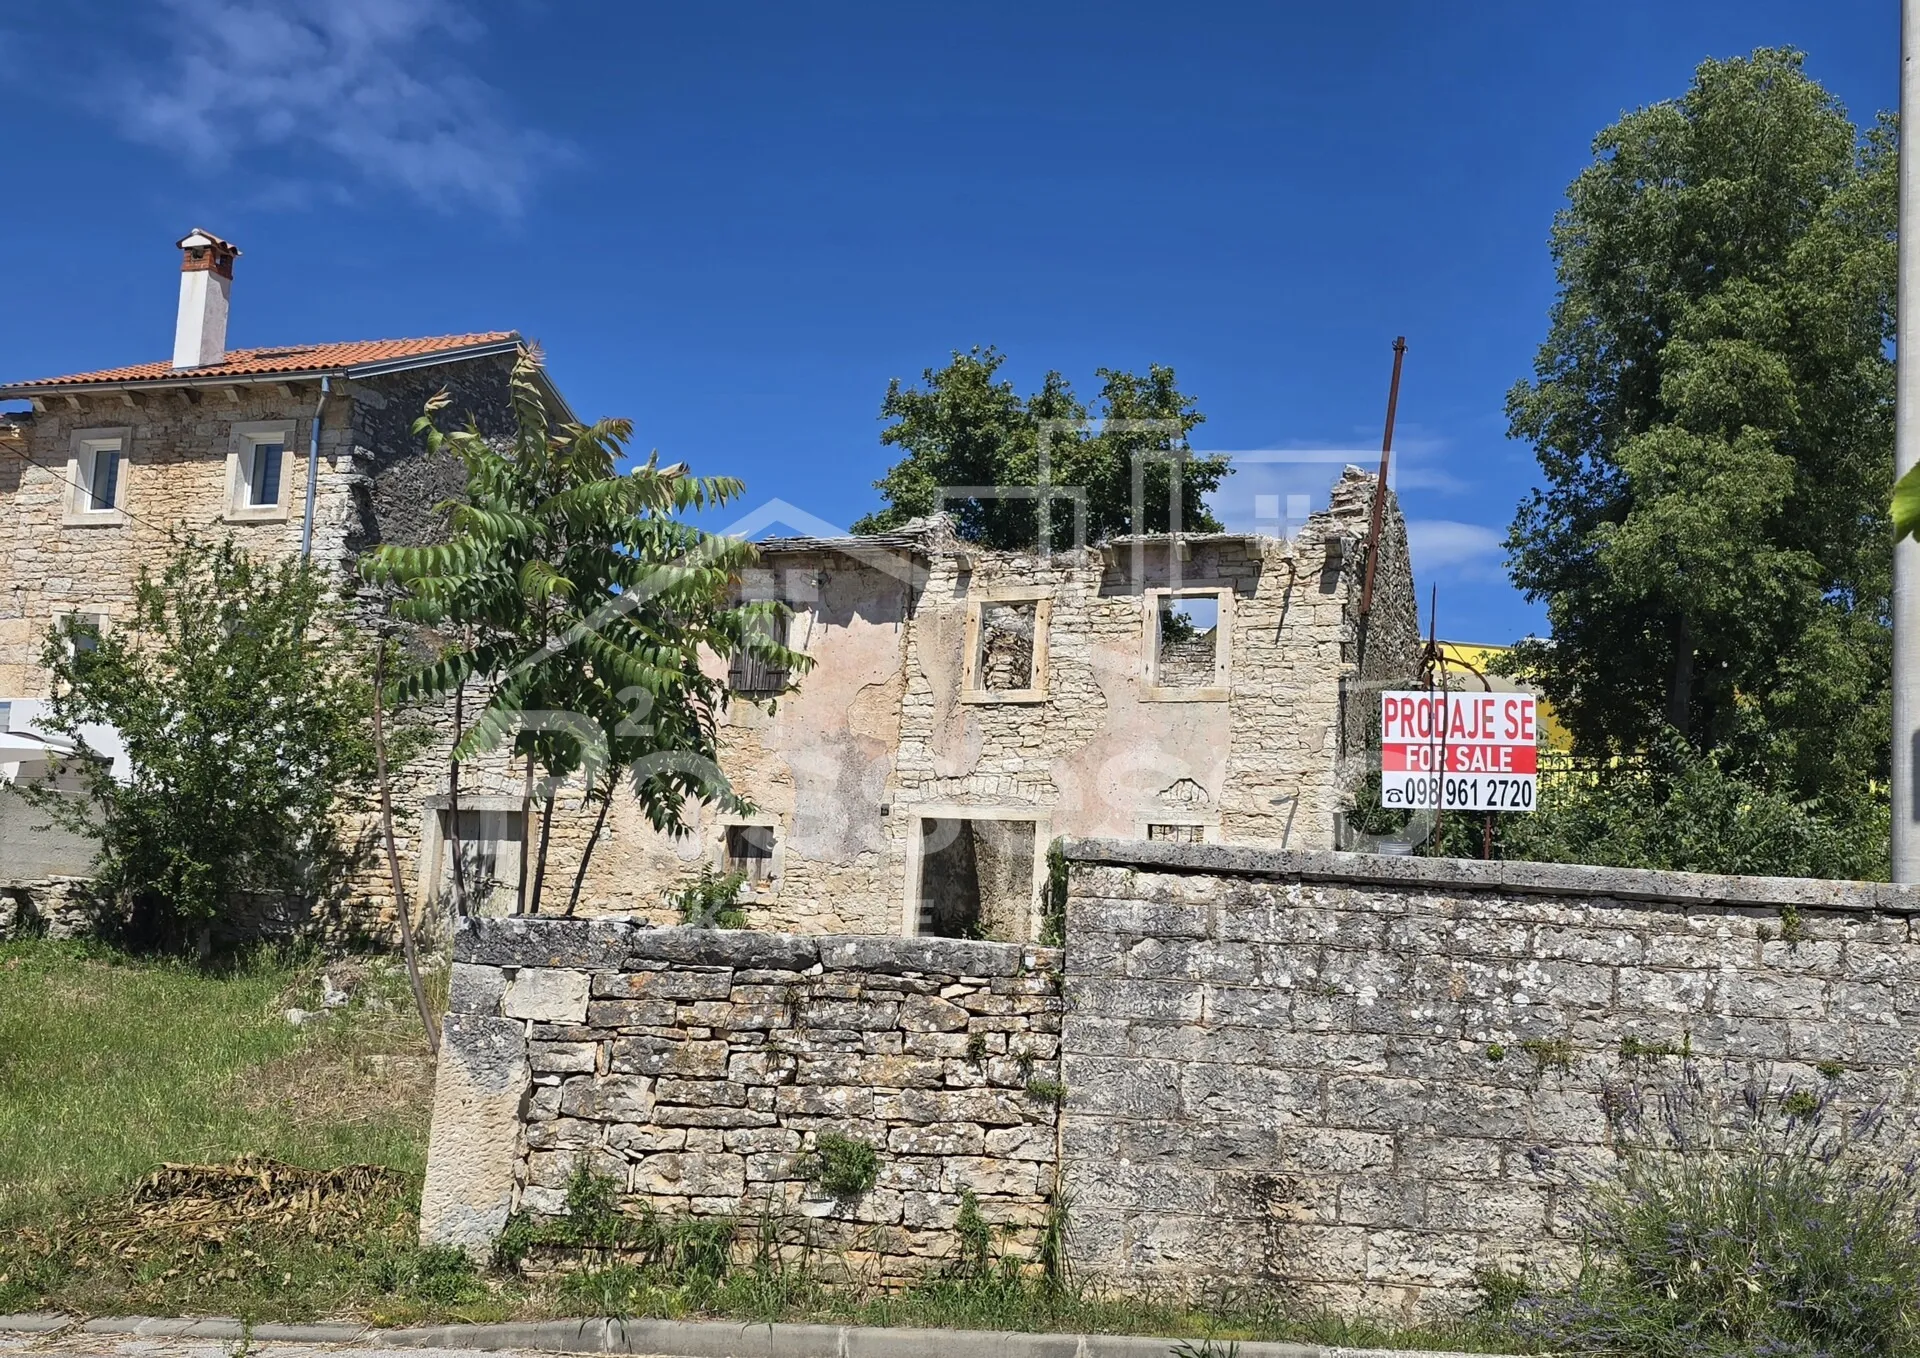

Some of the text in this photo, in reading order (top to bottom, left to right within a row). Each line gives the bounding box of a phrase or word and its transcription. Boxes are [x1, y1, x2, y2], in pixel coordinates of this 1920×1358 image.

[1384, 697, 1534, 740] PRODAJE SE
[1405, 745, 1513, 772] FOR SALE
[1405, 777, 1532, 807] 098 961 2720
